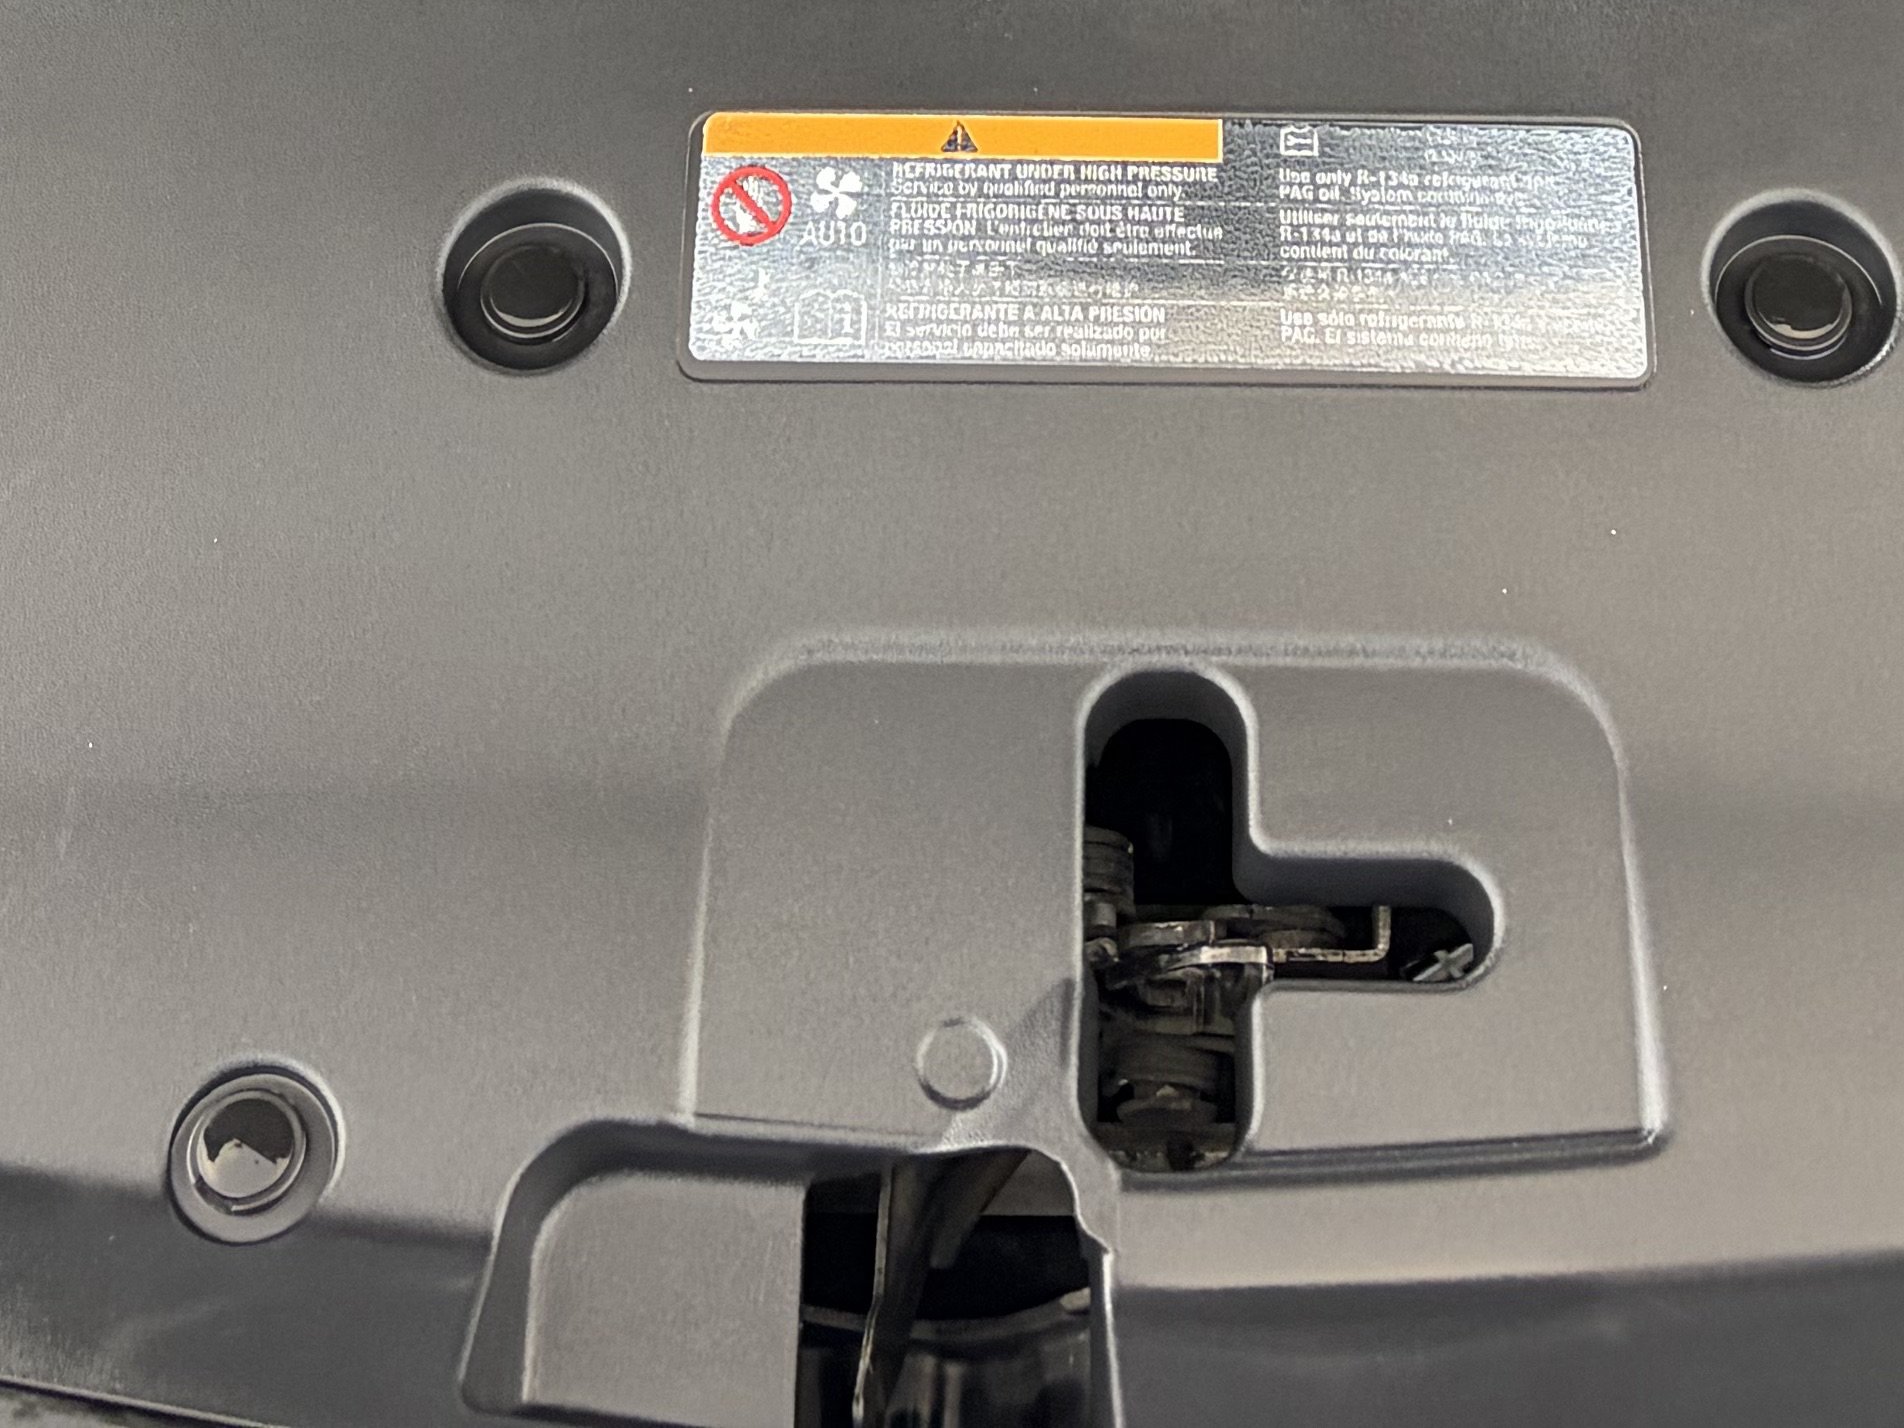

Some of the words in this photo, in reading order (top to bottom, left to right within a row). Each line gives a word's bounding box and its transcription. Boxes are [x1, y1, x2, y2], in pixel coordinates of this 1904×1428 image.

[891, 161, 1013, 180] REFRIGERANT
[1015, 163, 1076, 181] UNDER
[1080, 164, 1123, 181] HIGH
[1126, 165, 1219, 183] PRESSURE
[1315, 170, 1353, 188] only
[958, 181, 979, 197] by
[1147, 184, 1186, 202] only.
[1279, 185, 1315, 200] PAG
[1075, 205, 1124, 221] SOUS
[1127, 205, 1186, 223] HAUTE
[799, 221, 868, 246] AUTO
